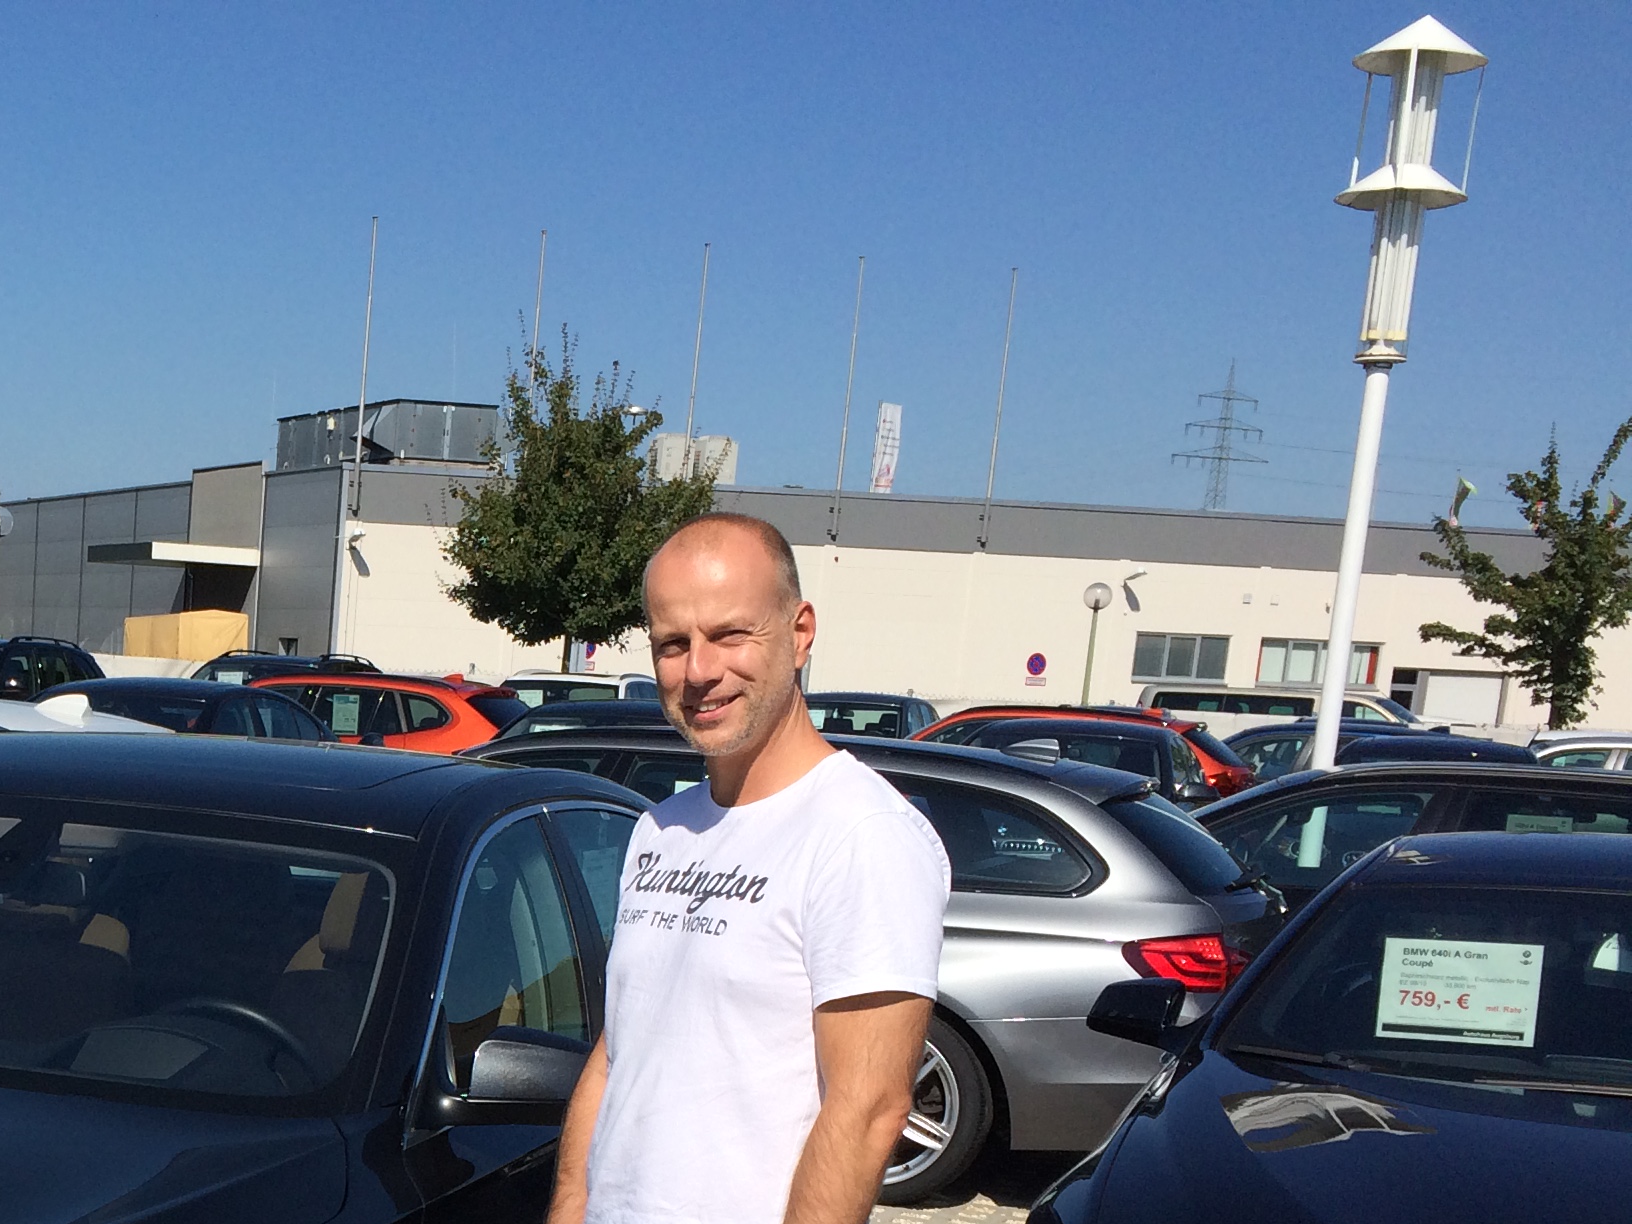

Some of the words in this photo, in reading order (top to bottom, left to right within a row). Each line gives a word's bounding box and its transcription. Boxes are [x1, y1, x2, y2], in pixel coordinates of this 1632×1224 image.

[625, 851, 769, 914] Huntington
[619, 908, 648, 925] SURF
[650, 911, 677, 930] THE
[681, 915, 728, 936] WORLD
[1401, 958, 1434, 968] Coupé
[1403, 947, 1429, 957] BMW
[1431, 949, 1451, 958] 640i
[1453, 950, 1462, 959] A
[1464, 950, 1489, 960] Gran
[1399, 989, 1451, 1011] 759,-
[1456, 993, 1471, 1010] €
